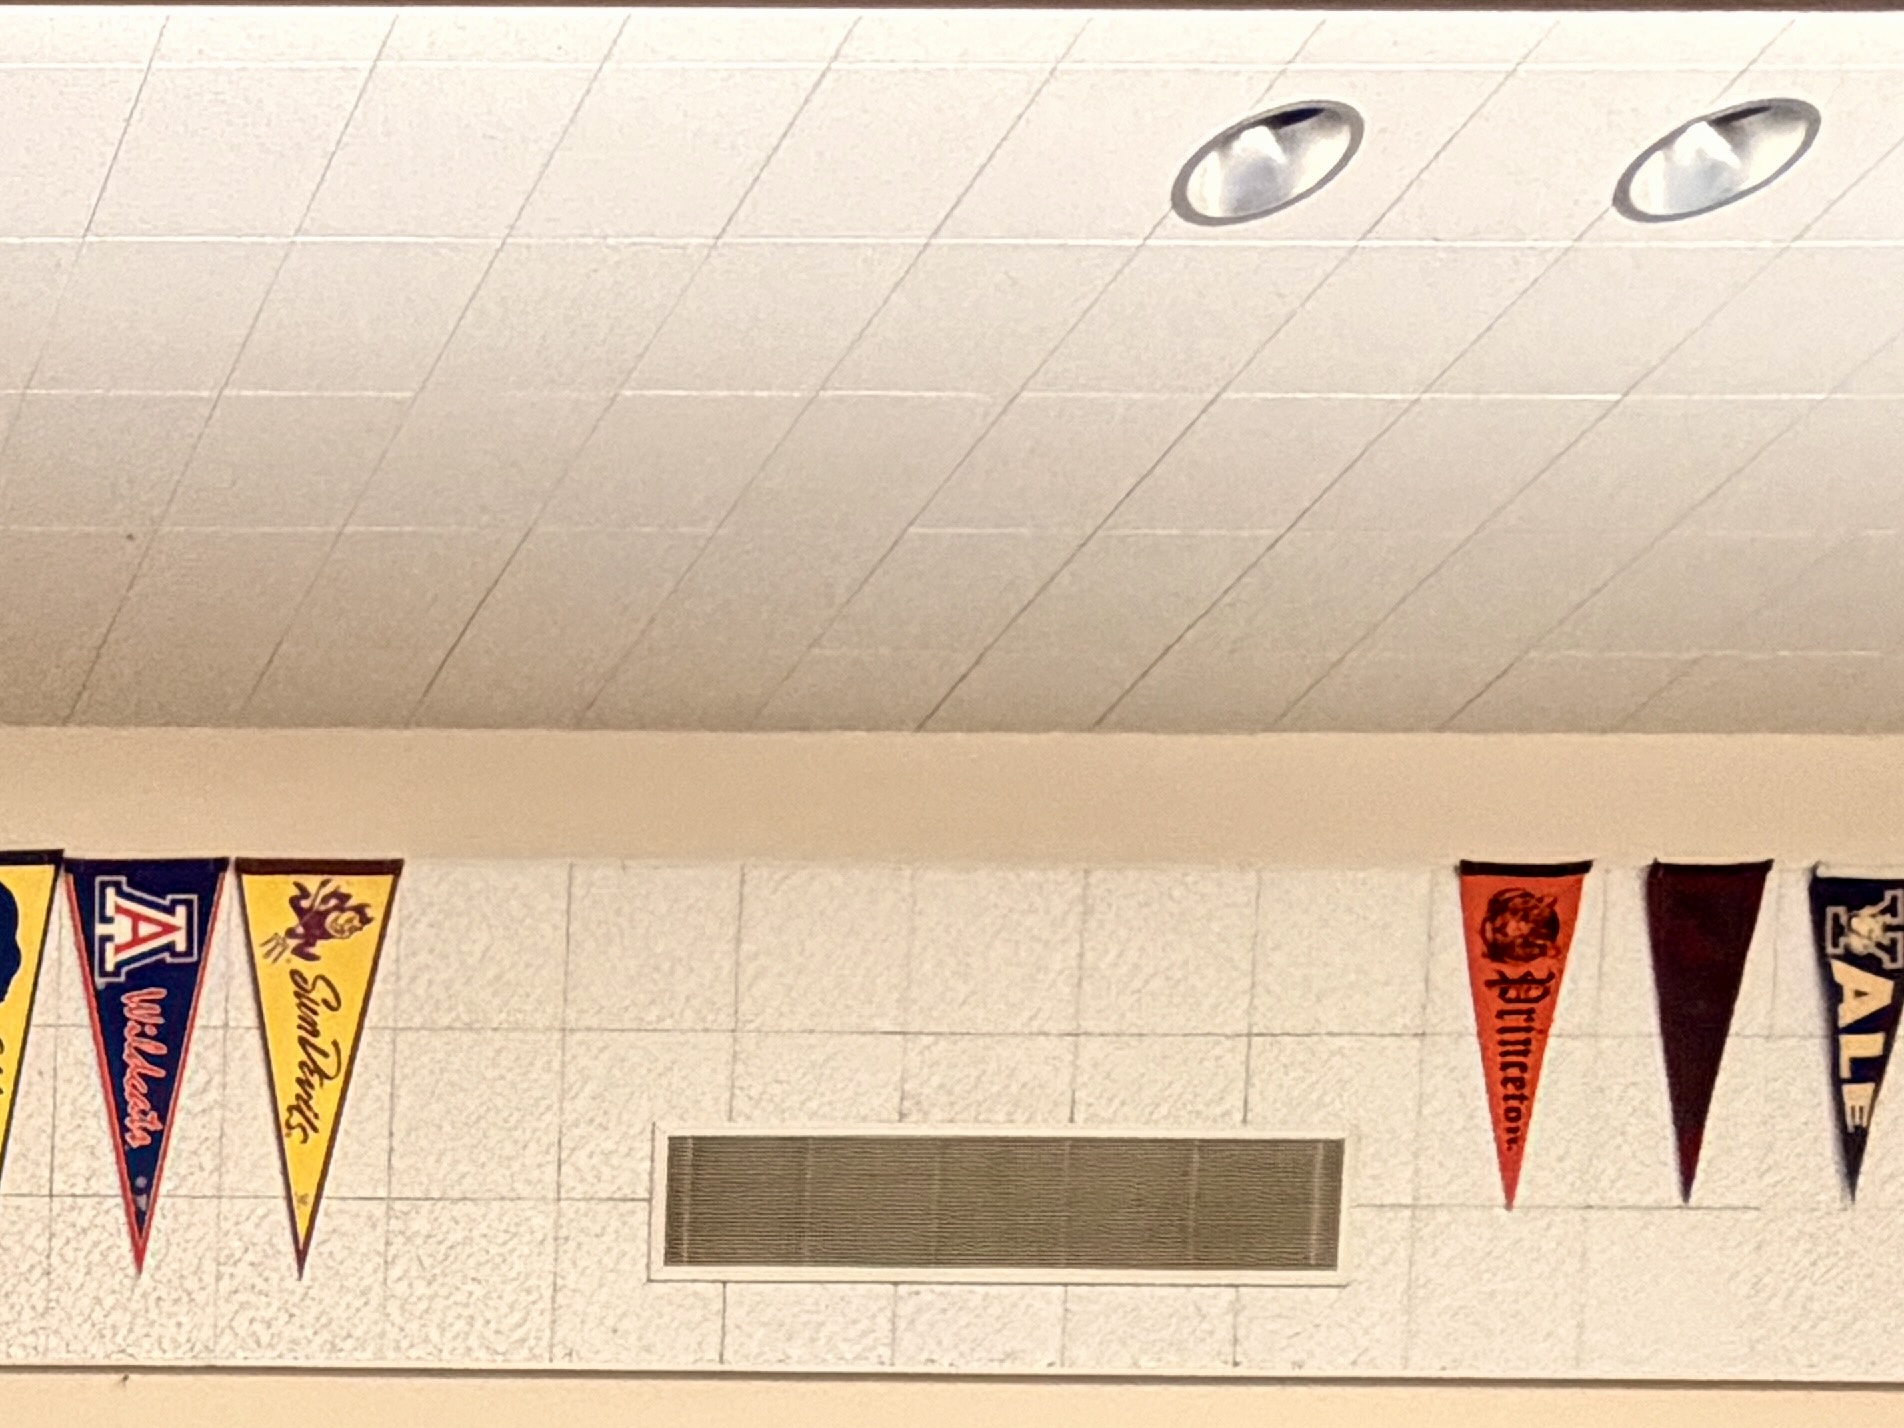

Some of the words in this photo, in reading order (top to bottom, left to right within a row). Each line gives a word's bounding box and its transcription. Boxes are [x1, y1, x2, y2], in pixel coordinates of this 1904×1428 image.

[95, 875, 198, 981] A
[121, 986, 168, 1149] Wildcats
[1485, 969, 1556, 1153] Princeton
